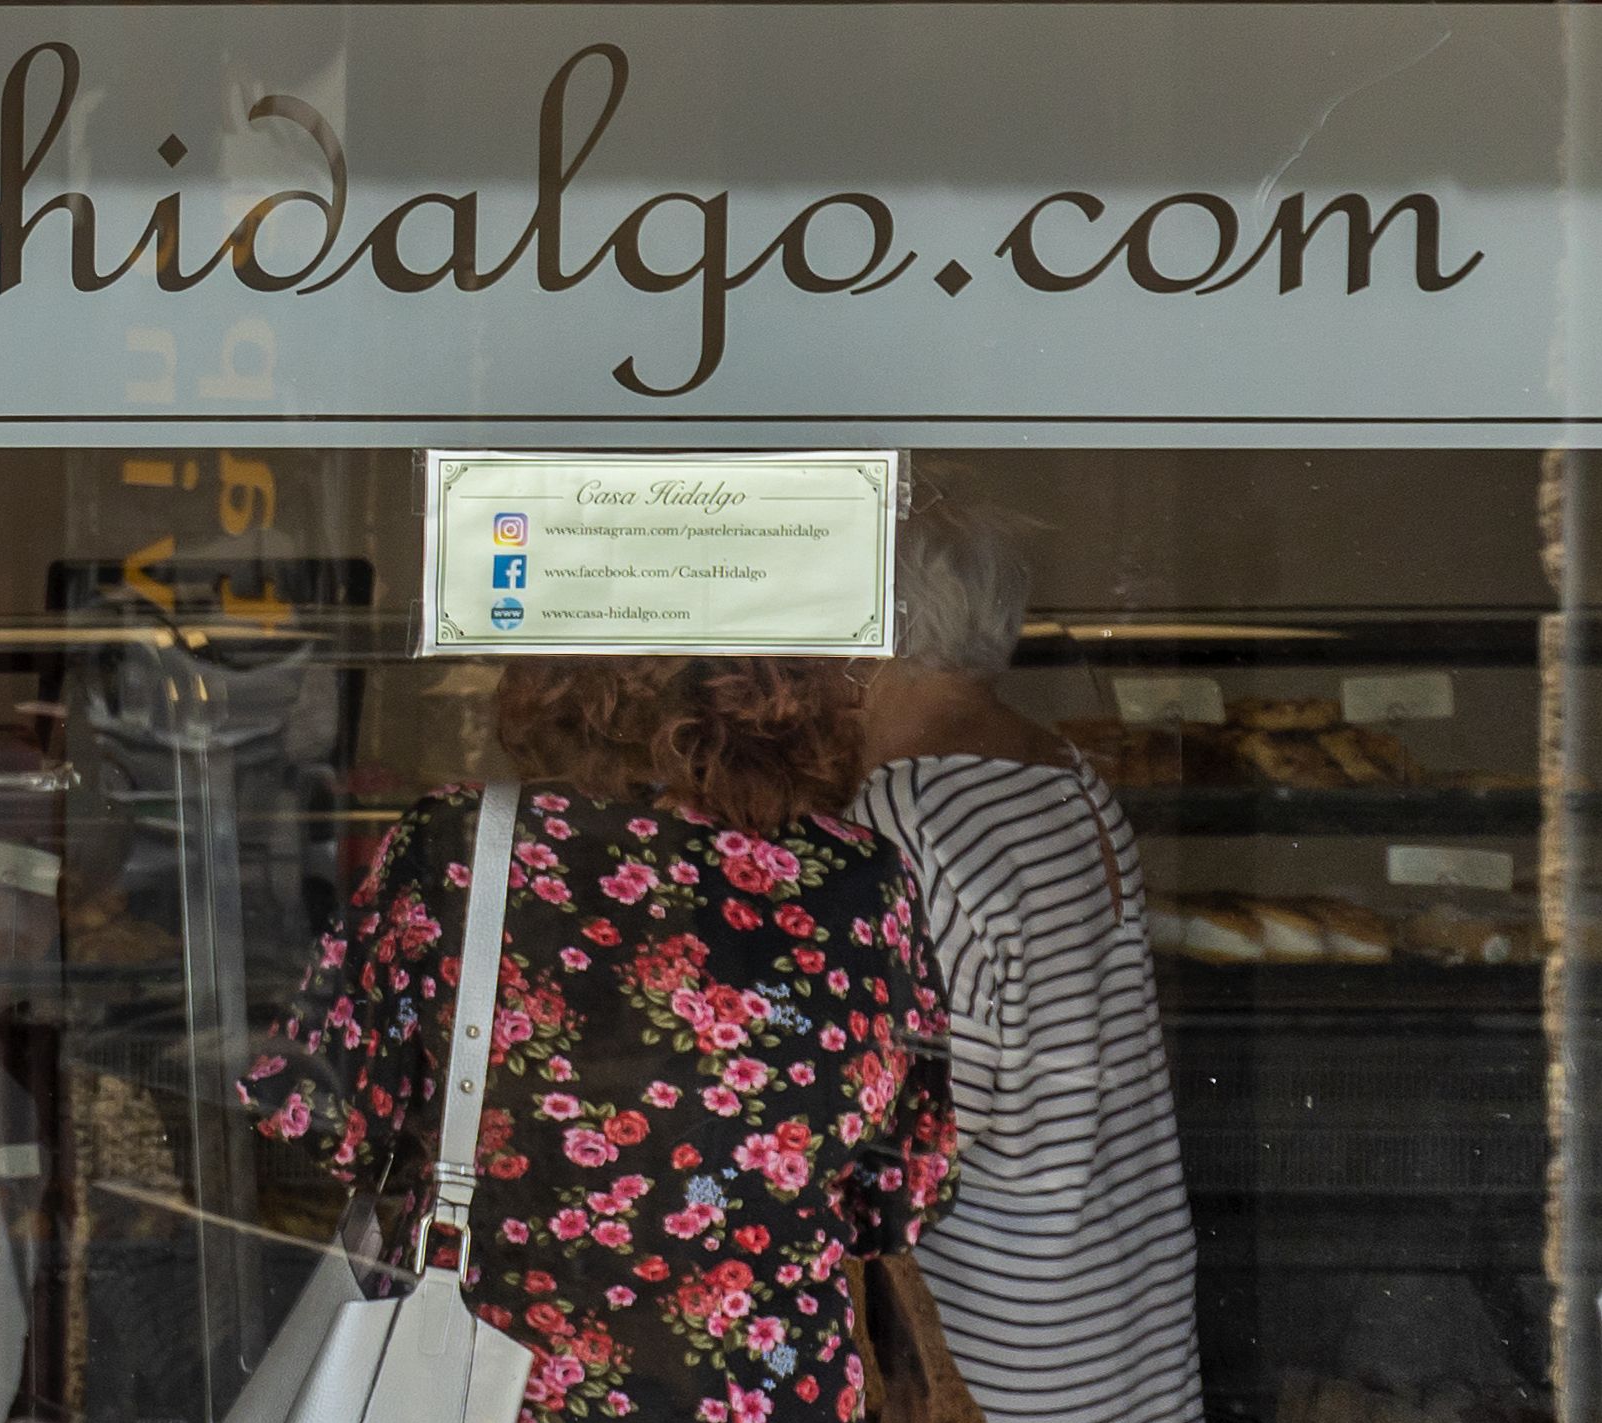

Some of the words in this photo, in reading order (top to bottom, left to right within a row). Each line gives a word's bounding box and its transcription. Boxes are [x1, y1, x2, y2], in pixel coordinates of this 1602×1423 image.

[576, 479, 638, 506] Casa
[645, 479, 747, 515] Hidalgo
[544, 523, 831, 541] www.instagram.com/pasteleriacasahidalgo
[544, 564, 768, 582] www.facebook.com/CasaHidalgo
[541, 606, 691, 622] www.casa-hidalgo.com
